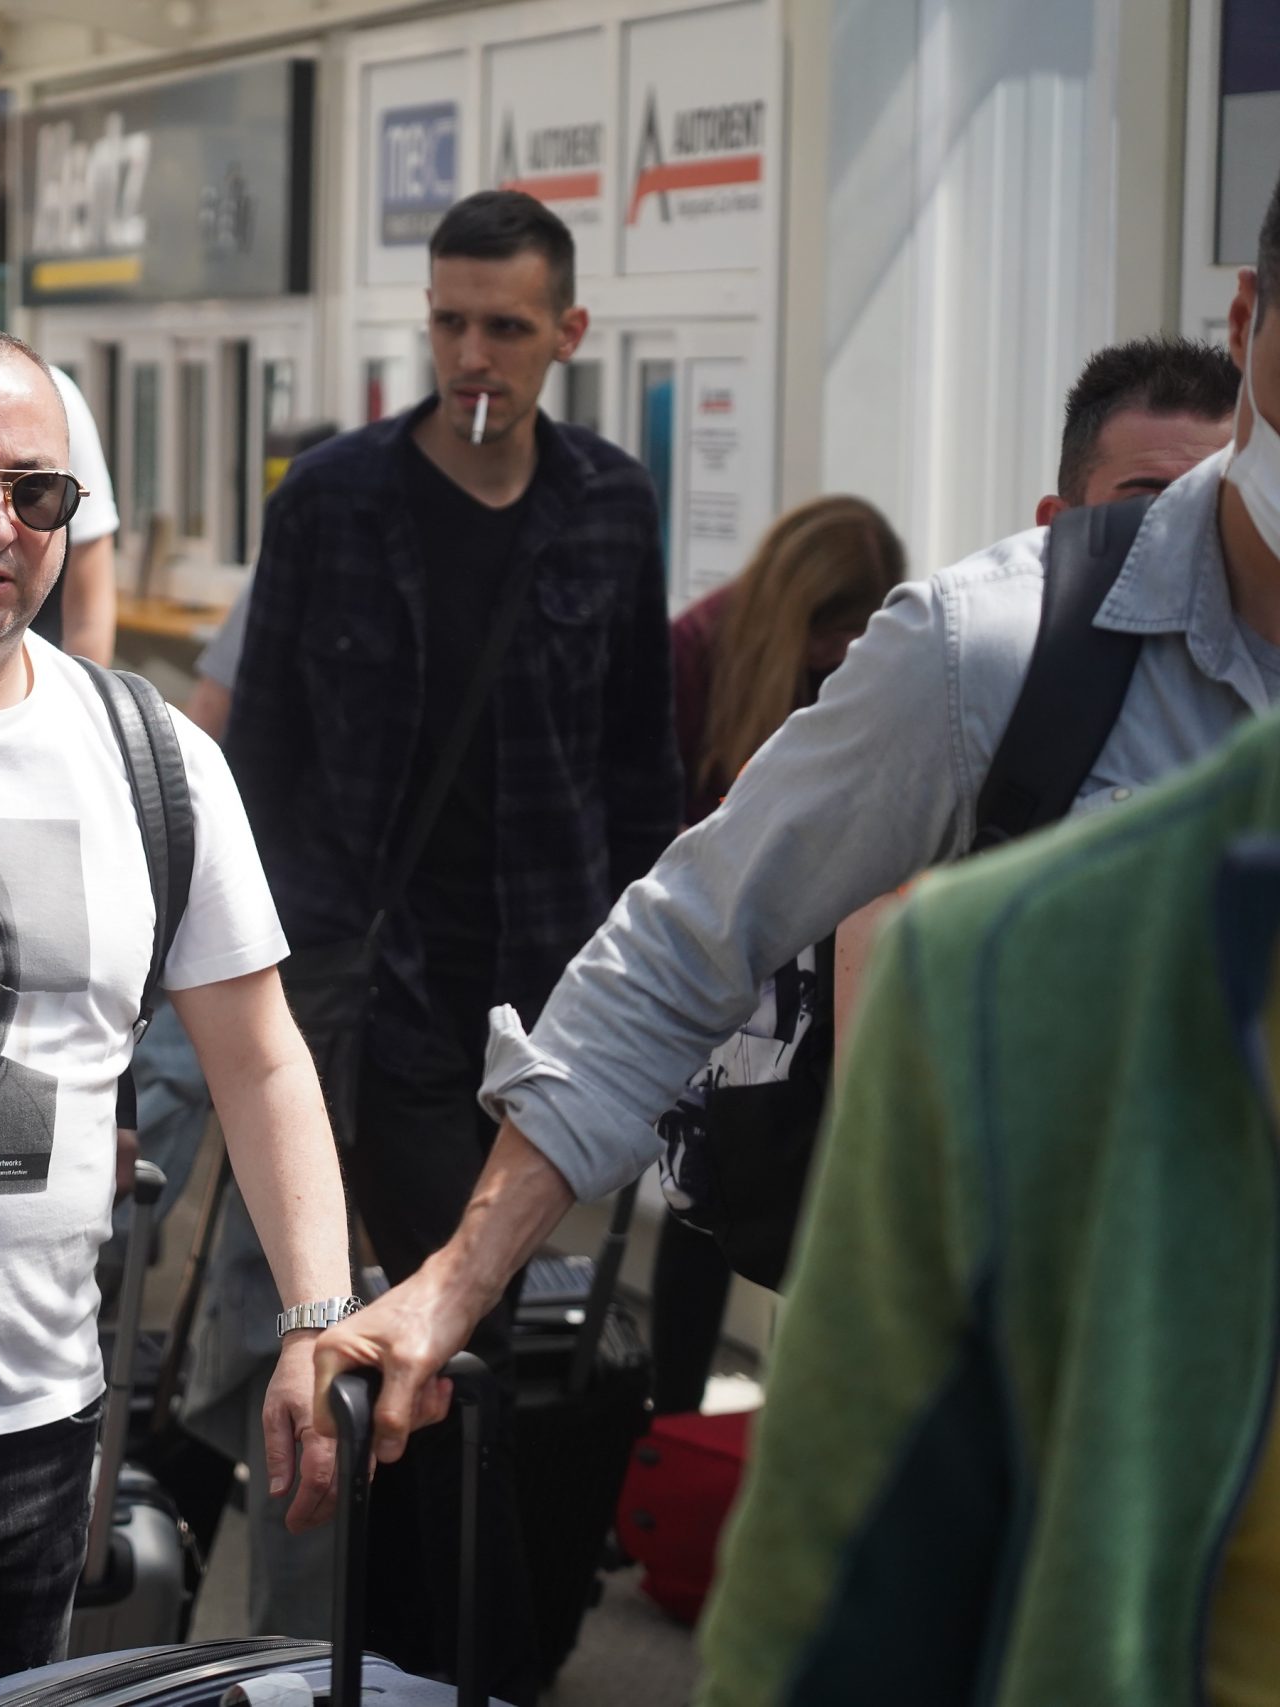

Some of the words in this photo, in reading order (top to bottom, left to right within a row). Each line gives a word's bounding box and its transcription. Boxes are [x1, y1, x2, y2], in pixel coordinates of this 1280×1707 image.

[527, 122, 604, 170] AUTORENT
[673, 98, 765, 154] AUTORENT
[32, 111, 151, 251] Hertz
